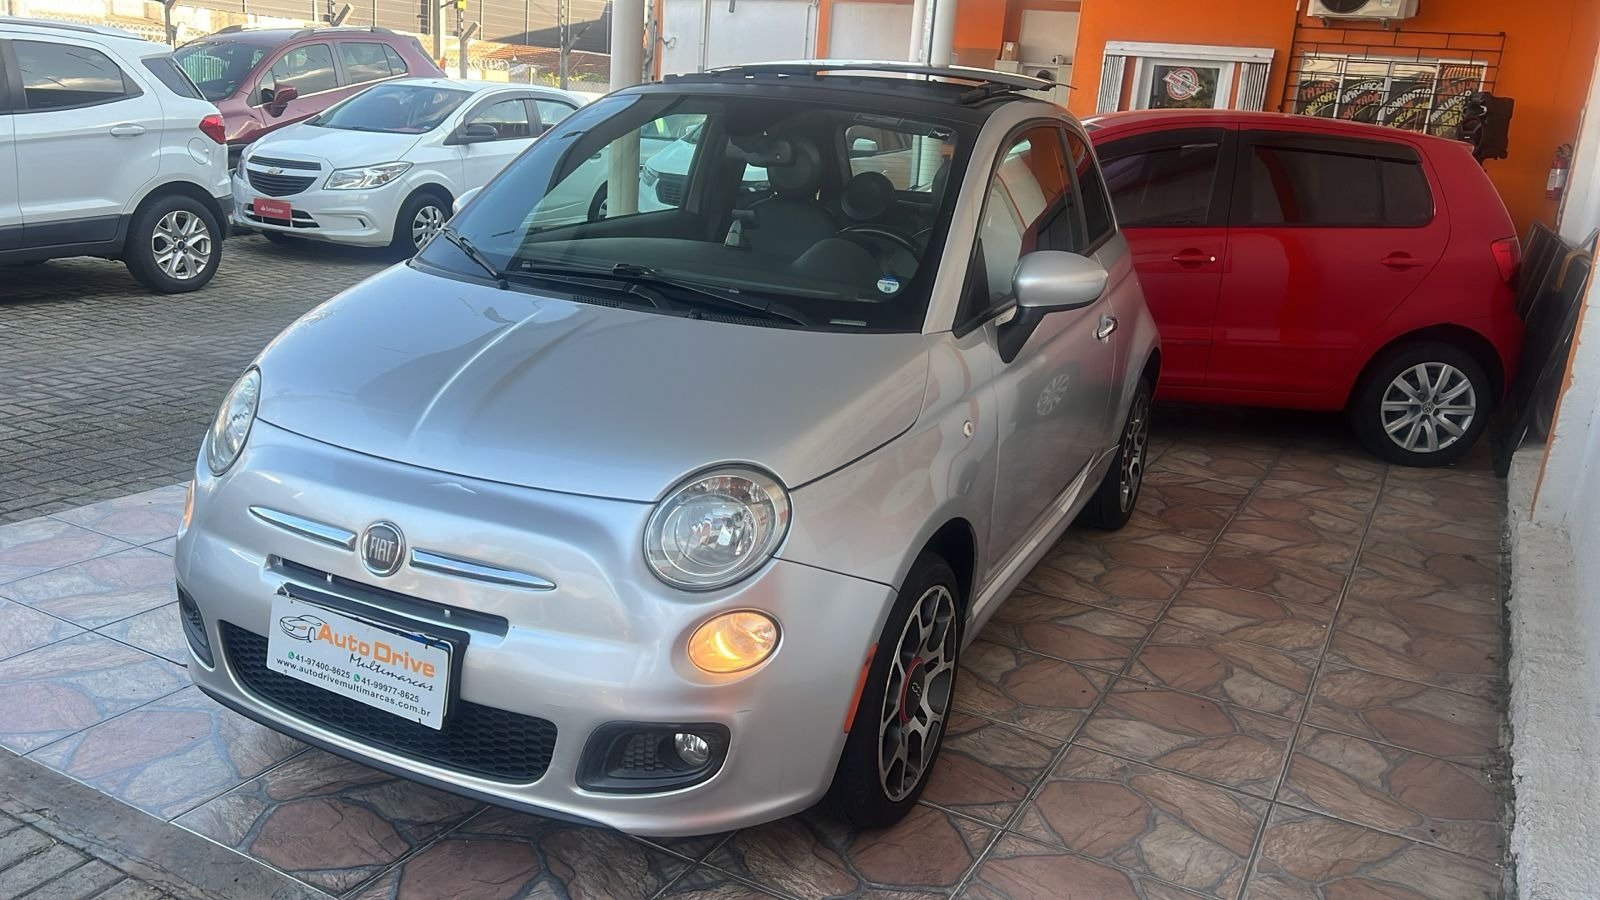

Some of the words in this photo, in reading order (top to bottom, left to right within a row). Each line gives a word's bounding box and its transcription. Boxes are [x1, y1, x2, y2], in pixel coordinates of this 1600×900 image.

[369, 536, 395, 562] FIAT
[276, 657, 431, 717] www.autodrivemultimarcas.com.br
[295, 654, 351, 679] 41-97400-8625
[361, 677, 420, 703] 41-99977-8625
[349, 653, 435, 692] Multimarcas
